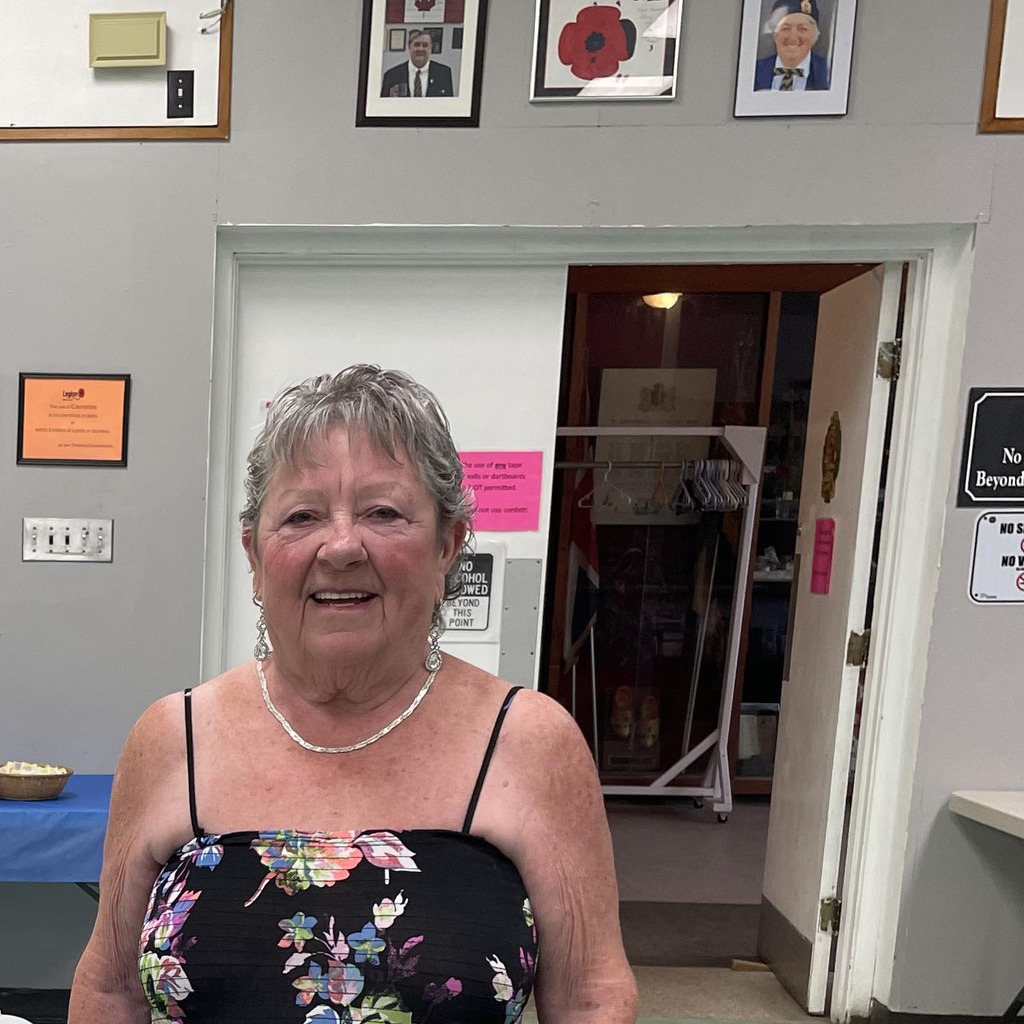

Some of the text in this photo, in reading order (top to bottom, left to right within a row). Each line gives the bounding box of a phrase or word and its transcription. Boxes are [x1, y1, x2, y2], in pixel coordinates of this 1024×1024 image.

[62, 390, 79, 399] Legion
[1002, 447, 1022, 464] No
[486, 461, 494, 469] of
[975, 469, 1024, 491] Beyond
[1000, 523, 1024, 535] NO S
[1001, 556, 1015, 567] NO
[453, 608, 472, 617] THIS
[448, 618, 474, 628] POINT
